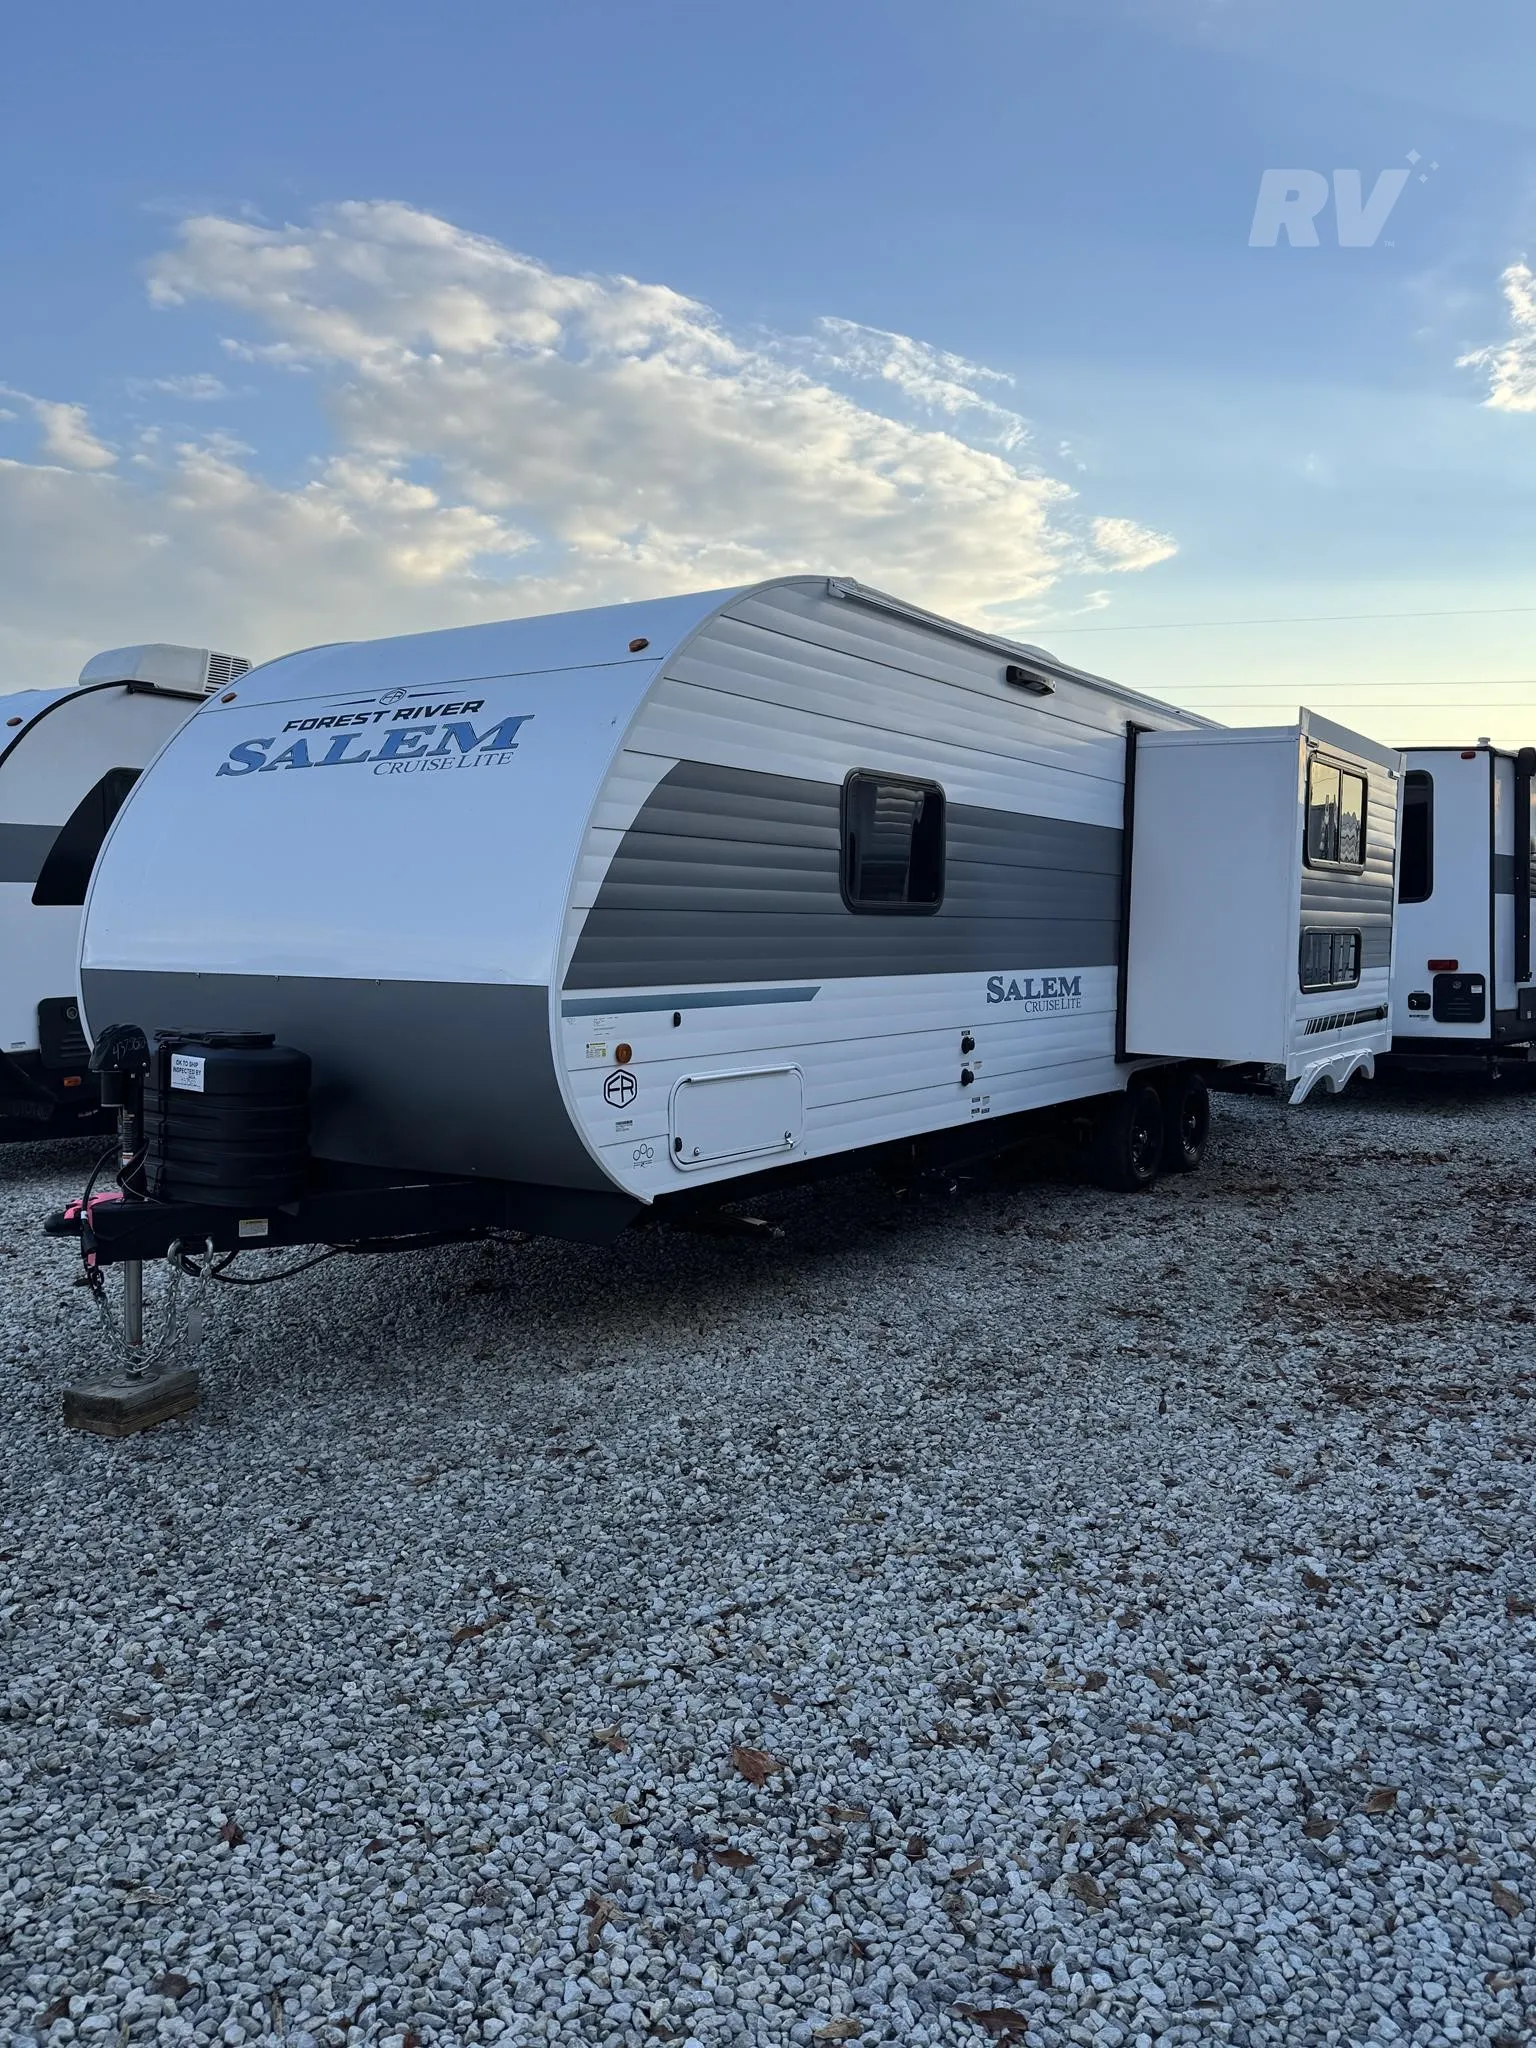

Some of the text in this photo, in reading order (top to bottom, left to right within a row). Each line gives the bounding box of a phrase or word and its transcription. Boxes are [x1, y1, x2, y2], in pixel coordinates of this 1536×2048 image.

[282, 700, 485, 733] FOREST RIVER
[215, 714, 535, 777] SALEM
[986, 975, 1082, 1004] SALEM
